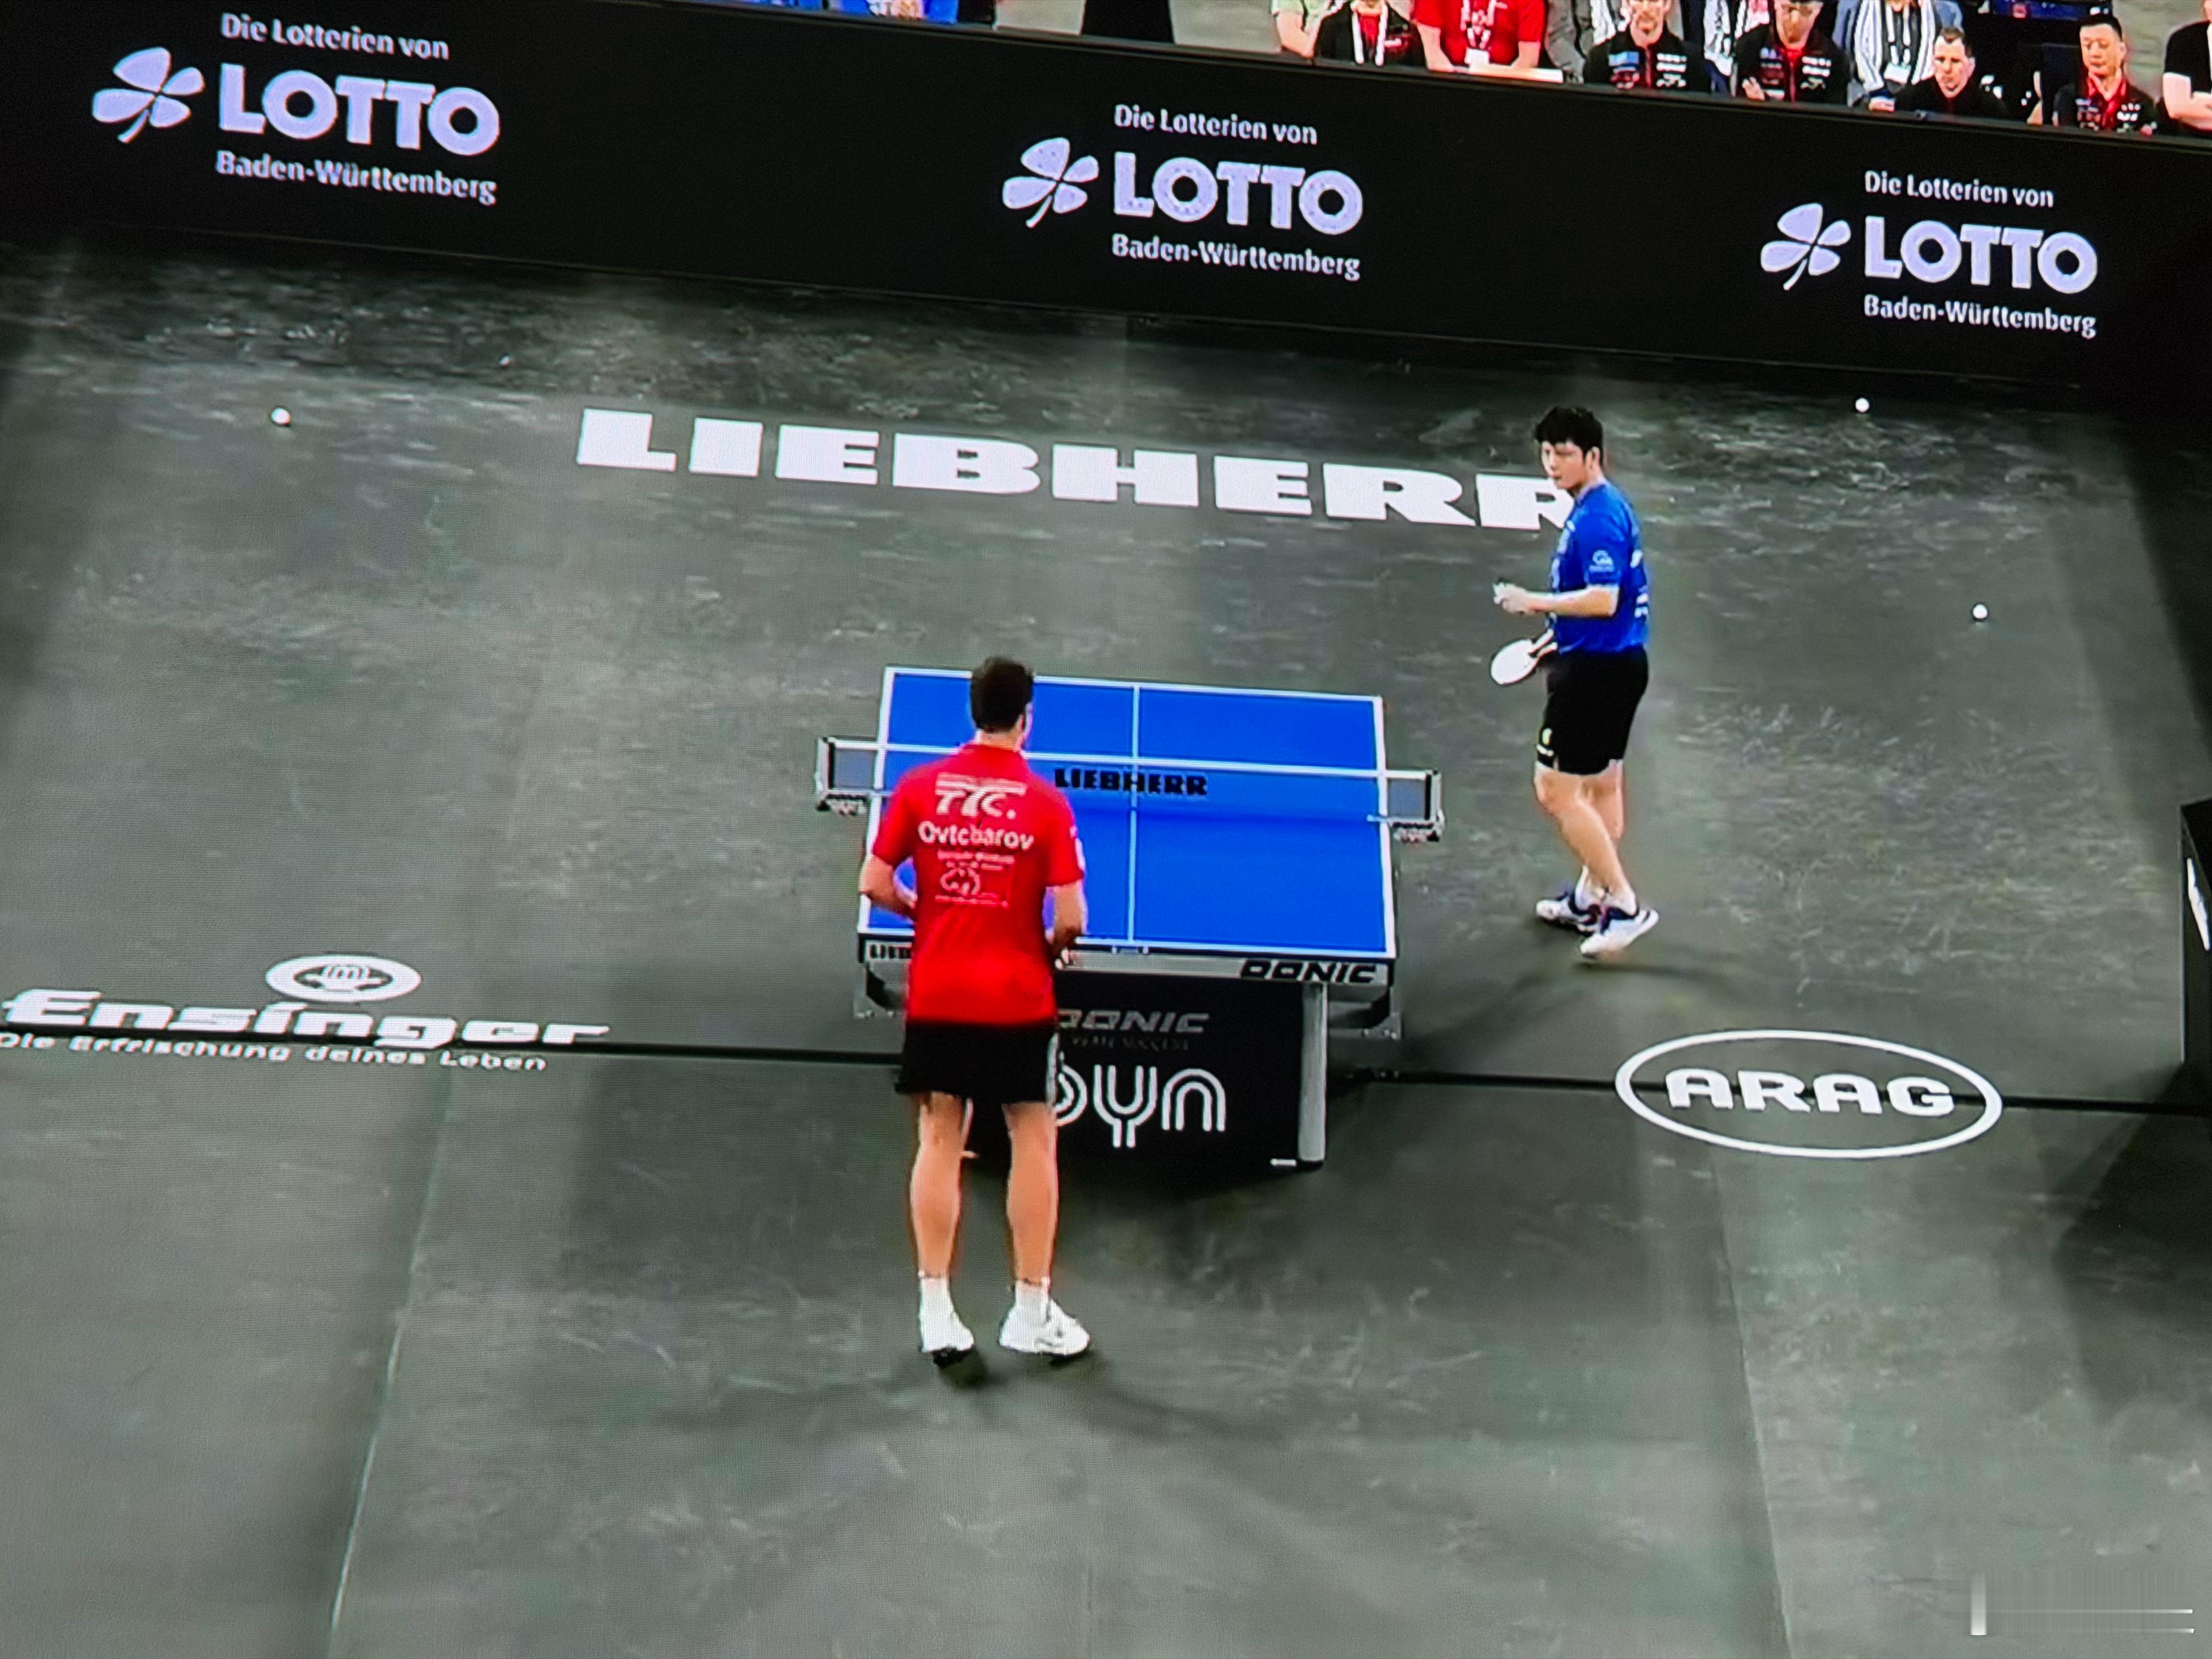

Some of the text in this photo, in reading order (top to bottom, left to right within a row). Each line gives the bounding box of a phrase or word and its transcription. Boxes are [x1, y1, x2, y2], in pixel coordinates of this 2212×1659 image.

[222, 13, 449, 60] Die Lotterien von
[219, 63, 500, 156] LOTTO
[1114, 104, 1318, 145] Die Lotterien von
[216, 150, 497, 206] Baden-Württemberg
[1114, 151, 1363, 235] LOTTO
[1865, 170, 2054, 207] Die Lotterien von
[1111, 233, 1361, 281] Baden-Württemberg
[1864, 216, 2098, 294] LOTTO
[1864, 294, 2097, 339] Baden-Württemberg
[575, 408, 1575, 530] LIEBHERR
[1054, 768, 1207, 795] LIEBHERR
[1240, 960, 1376, 984] DONIC
[2, 989, 610, 1050] Ensinger
[0, 1032, 546, 1070] Die Erfrischung deines Leben
[1665, 1068, 1954, 1116] ARAG
